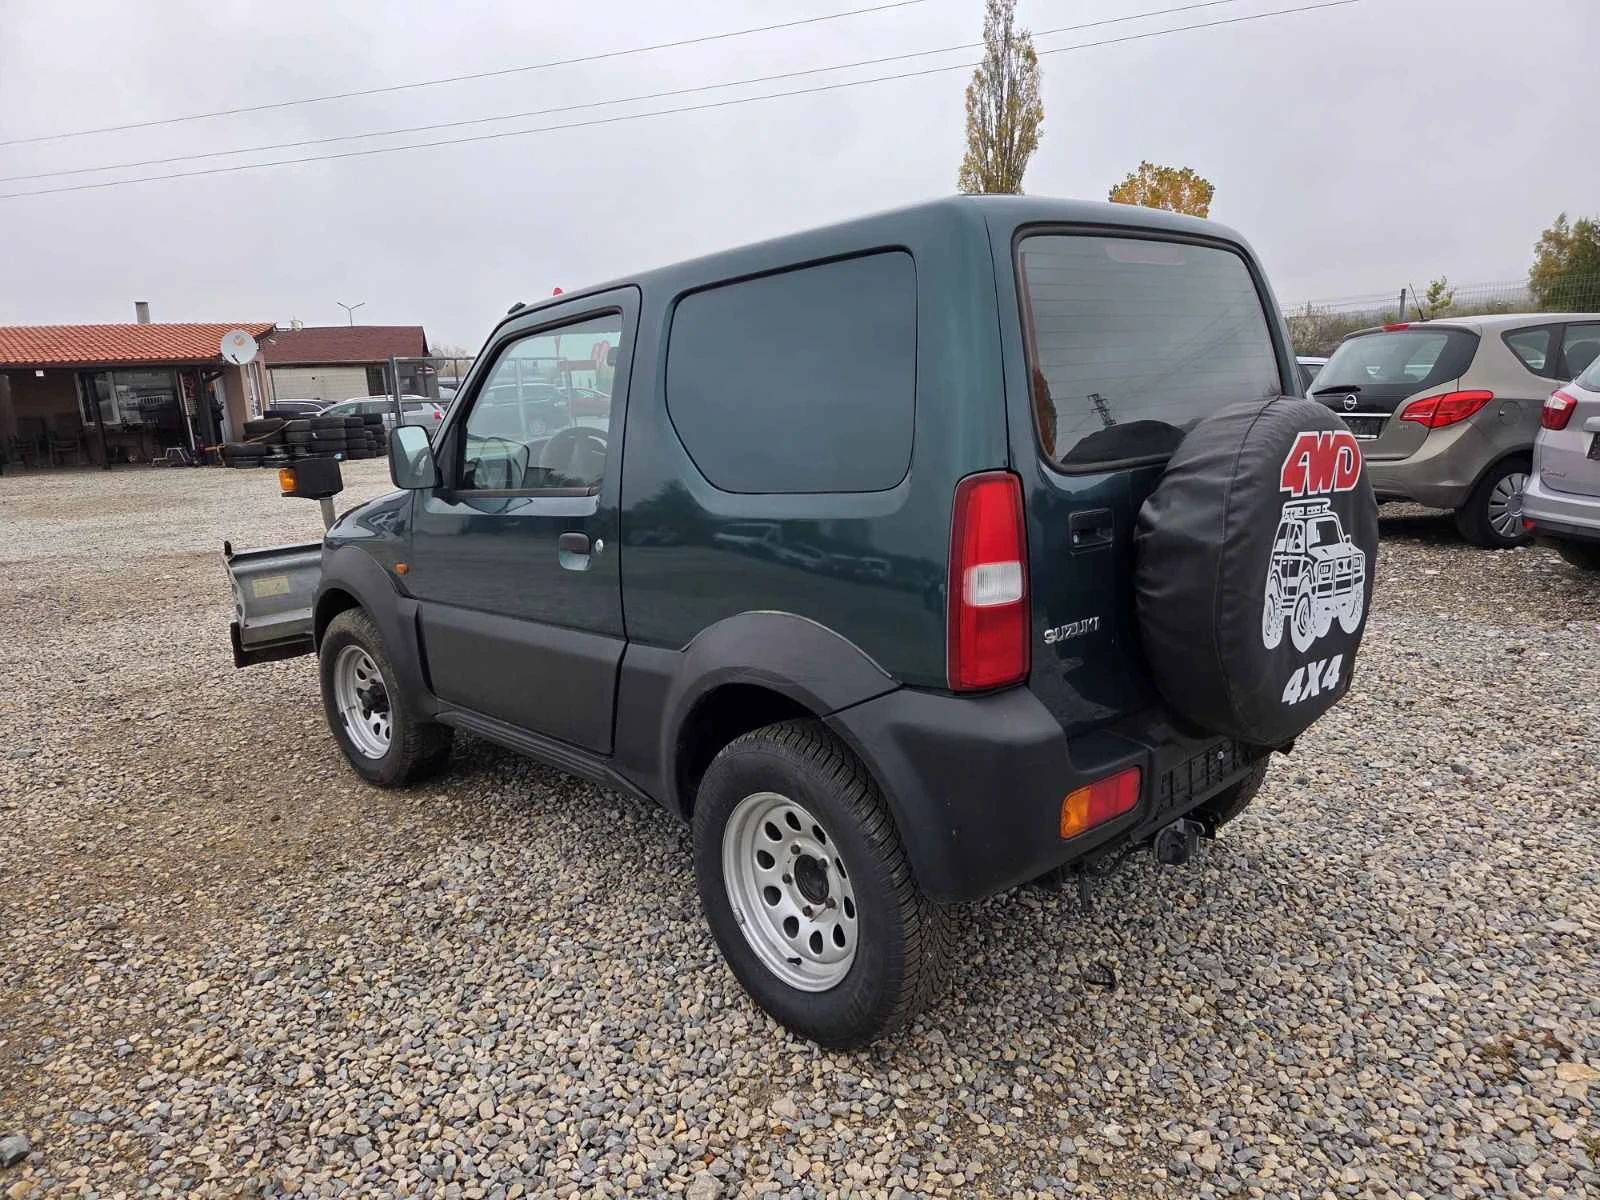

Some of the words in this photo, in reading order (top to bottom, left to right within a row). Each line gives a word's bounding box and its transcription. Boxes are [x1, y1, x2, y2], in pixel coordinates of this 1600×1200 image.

[1280, 430, 1361, 497] 4WD
[1044, 616, 1100, 645] SUZUKI
[1281, 654, 1343, 705] 4X4
